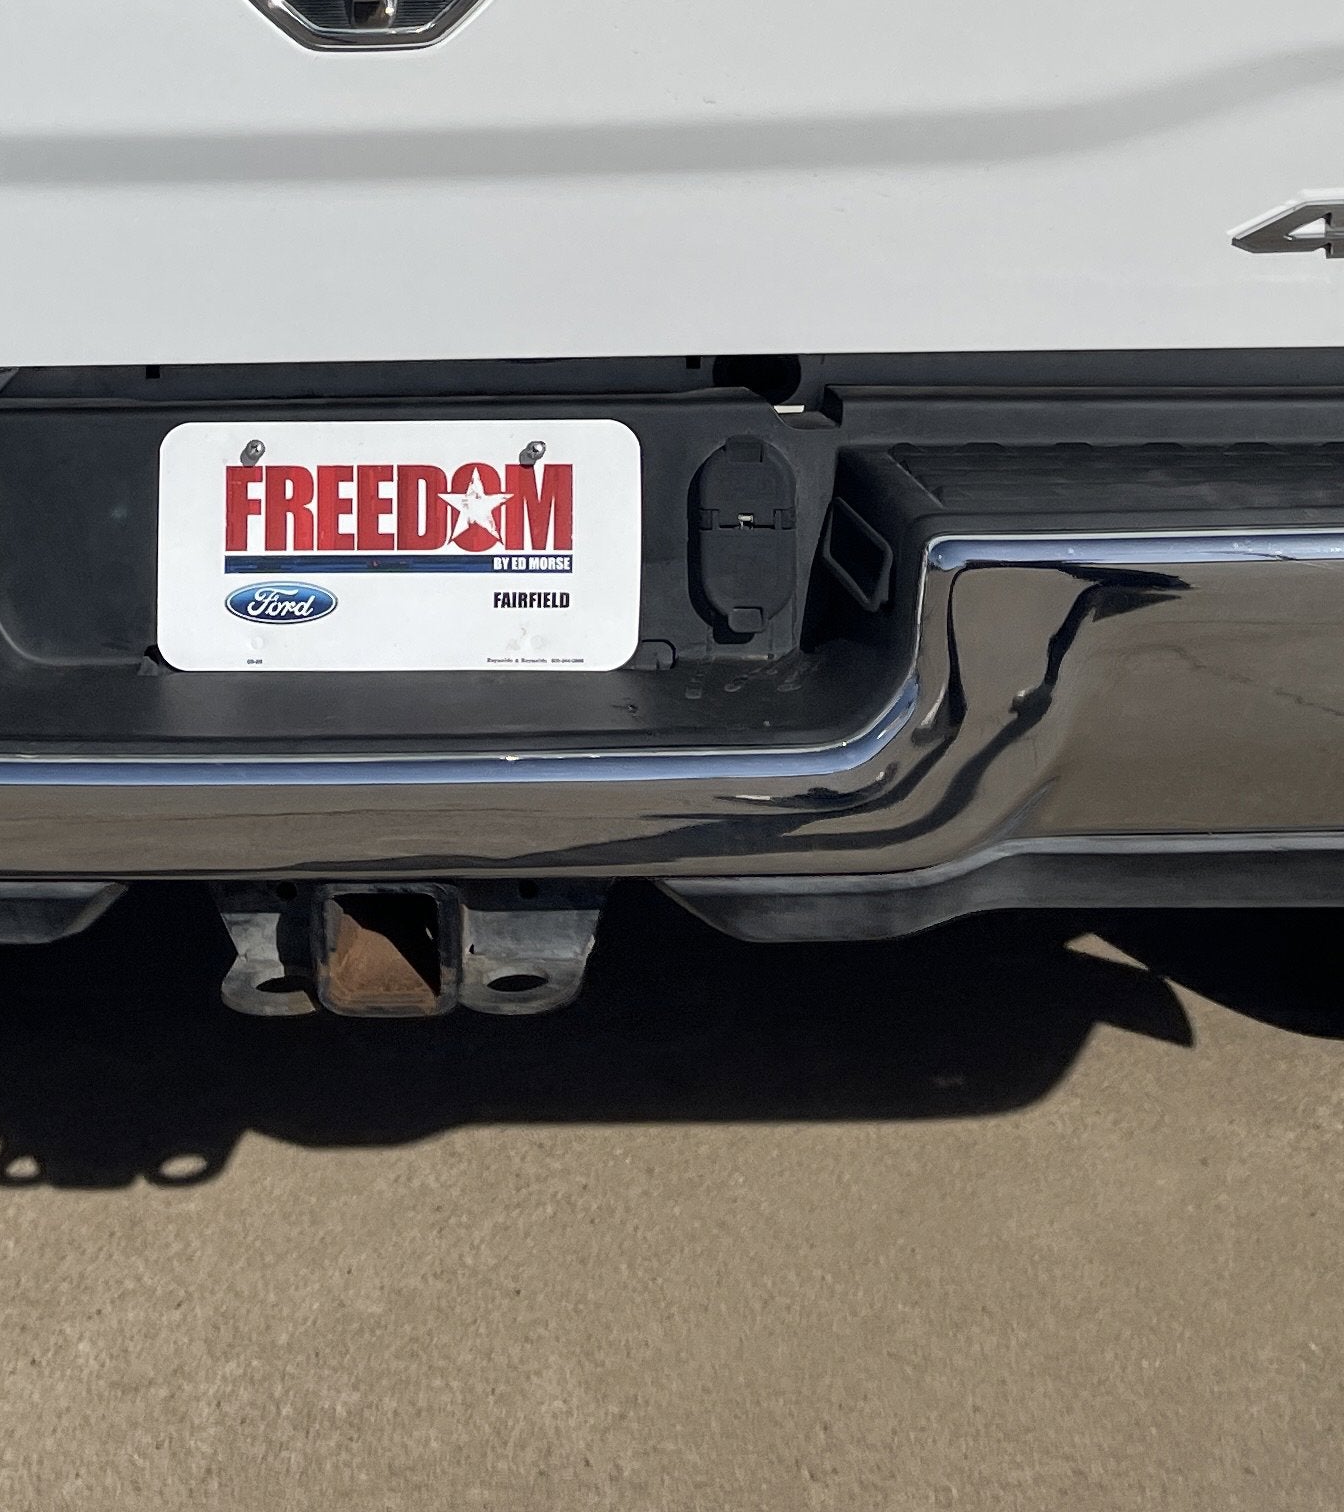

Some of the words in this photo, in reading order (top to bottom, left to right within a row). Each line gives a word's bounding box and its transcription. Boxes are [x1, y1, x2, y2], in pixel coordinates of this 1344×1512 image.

[225, 463, 573, 552] FREEDOM
[493, 556, 510, 570] BY
[511, 556, 527, 570] ED
[528, 556, 571, 570] MORSE
[247, 587, 316, 617] Ford
[493, 591, 570, 609] FAIRFIELD
